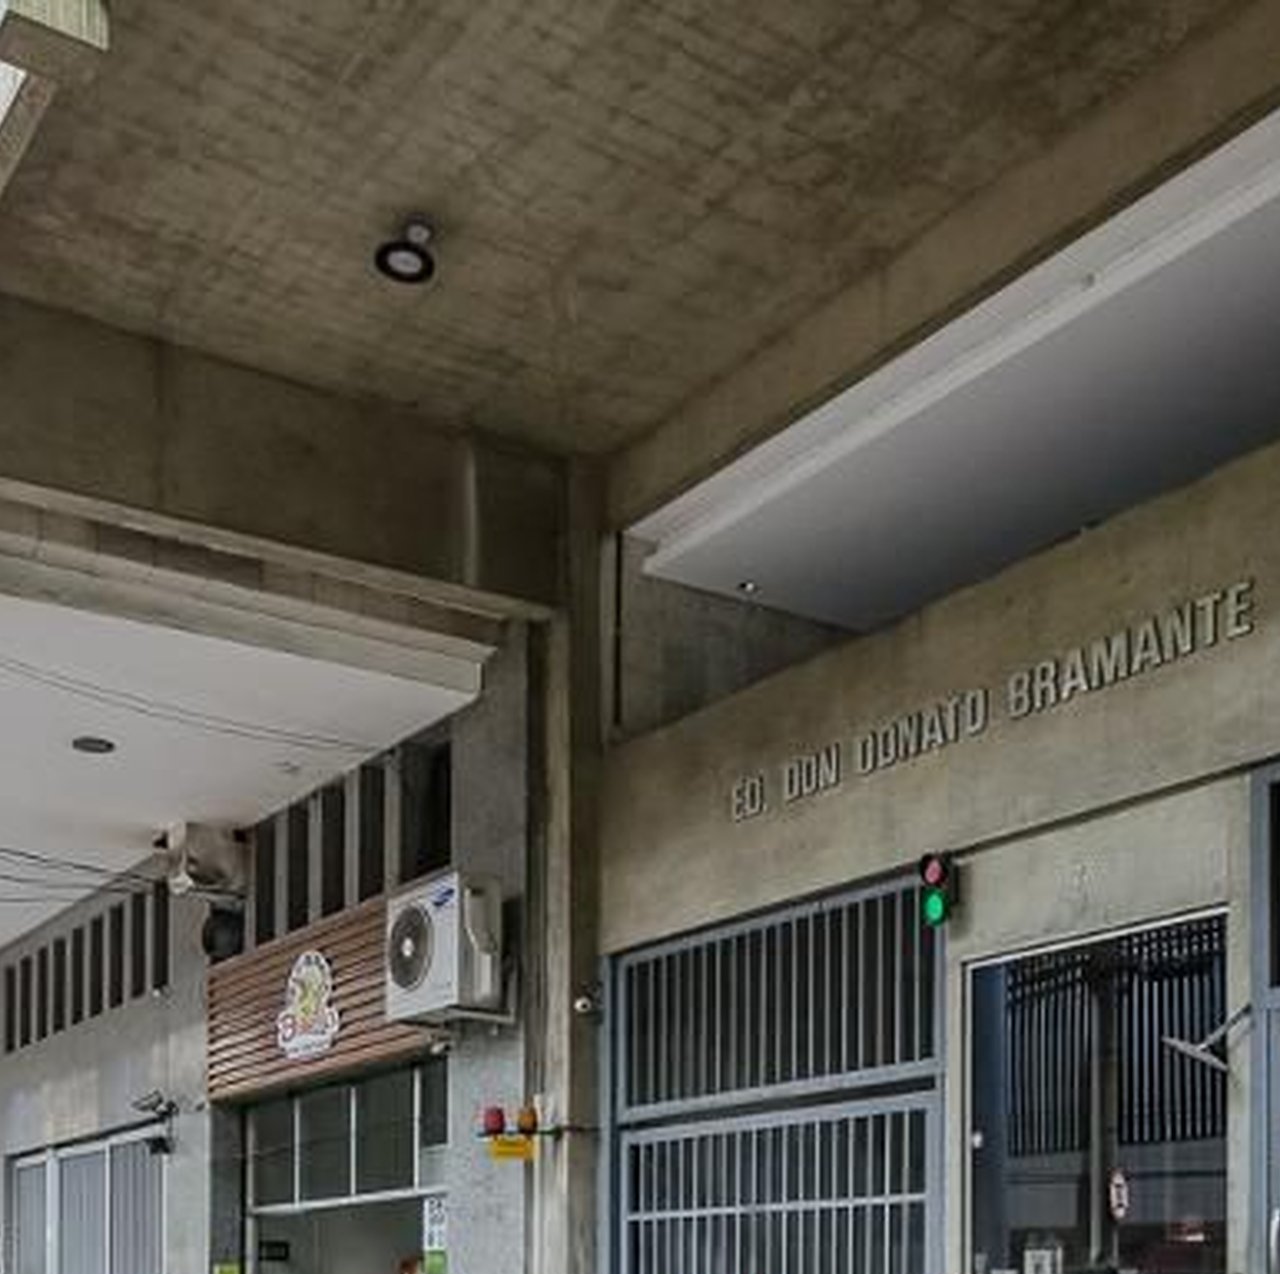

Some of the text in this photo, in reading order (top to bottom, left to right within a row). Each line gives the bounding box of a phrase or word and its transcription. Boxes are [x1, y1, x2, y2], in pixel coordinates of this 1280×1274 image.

[784, 743, 839, 800] DON
[858, 688, 989, 774] DONATO
[1008, 580, 1255, 720] BRAMANTE
